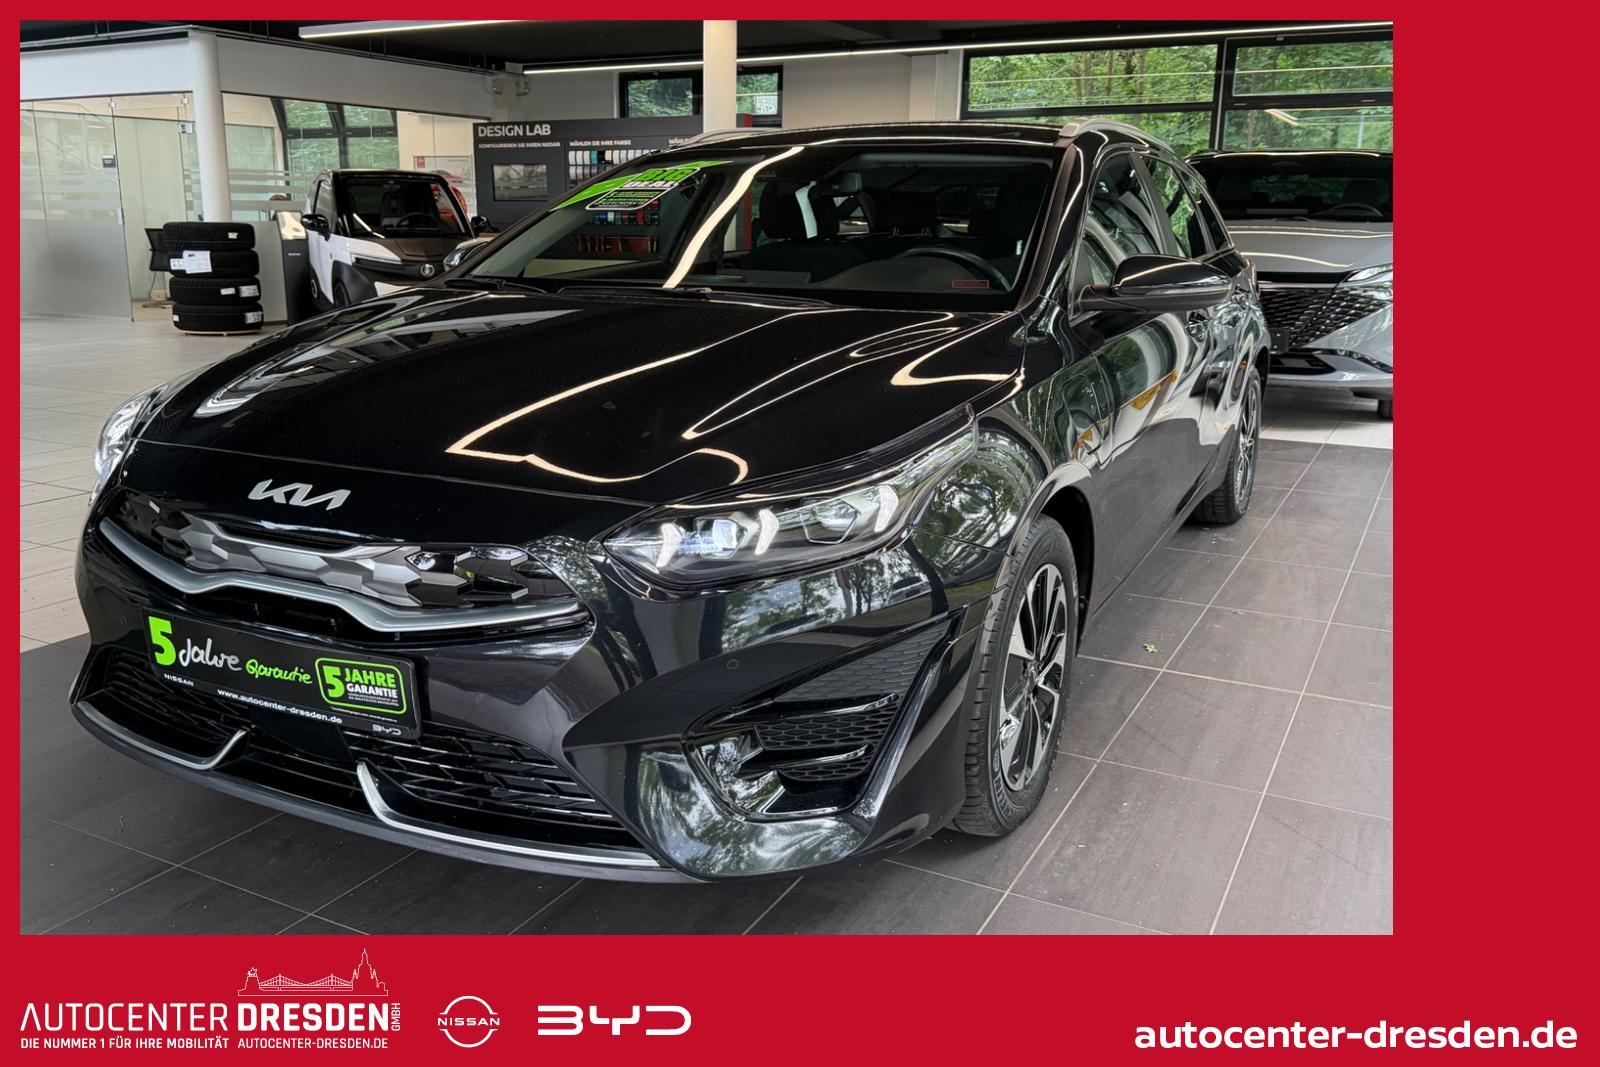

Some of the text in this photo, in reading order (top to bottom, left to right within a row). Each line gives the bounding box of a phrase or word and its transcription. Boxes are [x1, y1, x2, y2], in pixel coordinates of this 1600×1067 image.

[478, 124, 552, 137] DESIGN LAB
[569, 139, 591, 147] WÄHLEN
[248, 478, 351, 511] KIA
[148, 616, 313, 684] 5 Jahre Garantie
[163, 673, 194, 687] NISSAN
[322, 665, 345, 698] 5
[344, 667, 396, 688] JAHRE
[346, 683, 398, 699] GARANTIE
[217, 688, 343, 724] www.autocenter-dresden.de
[372, 724, 402, 736] BYD
